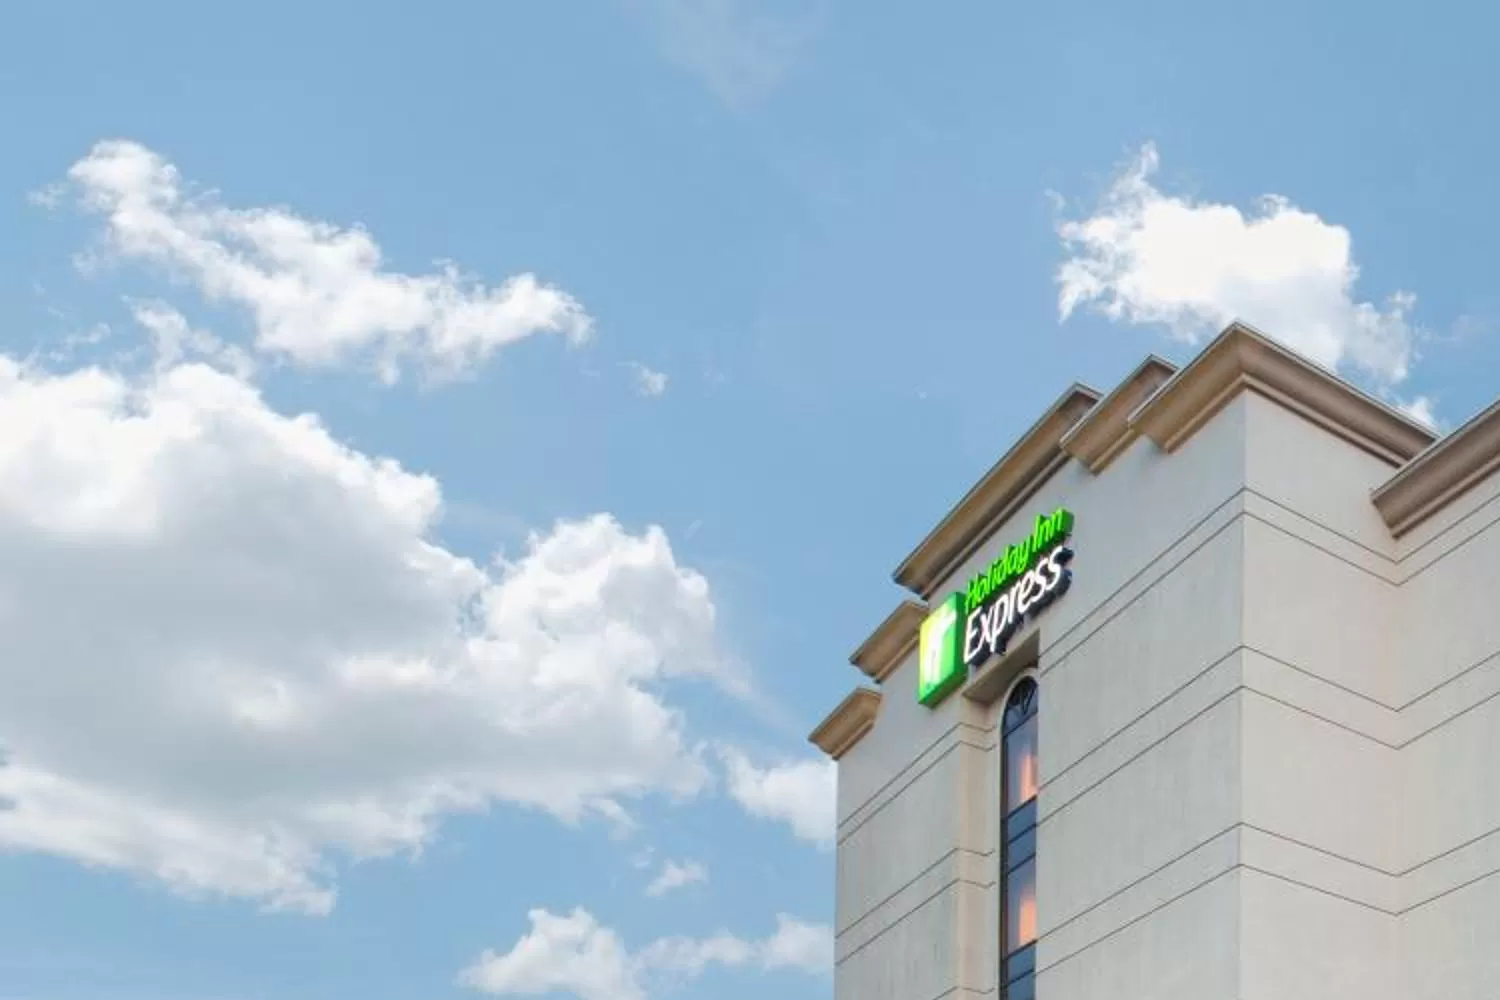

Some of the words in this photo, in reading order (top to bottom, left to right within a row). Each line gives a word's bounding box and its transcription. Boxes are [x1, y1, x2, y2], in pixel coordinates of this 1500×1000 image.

[964, 545, 1063, 663] Express
[965, 533, 1033, 614] Holiday
[1033, 508, 1064, 549] Inn
